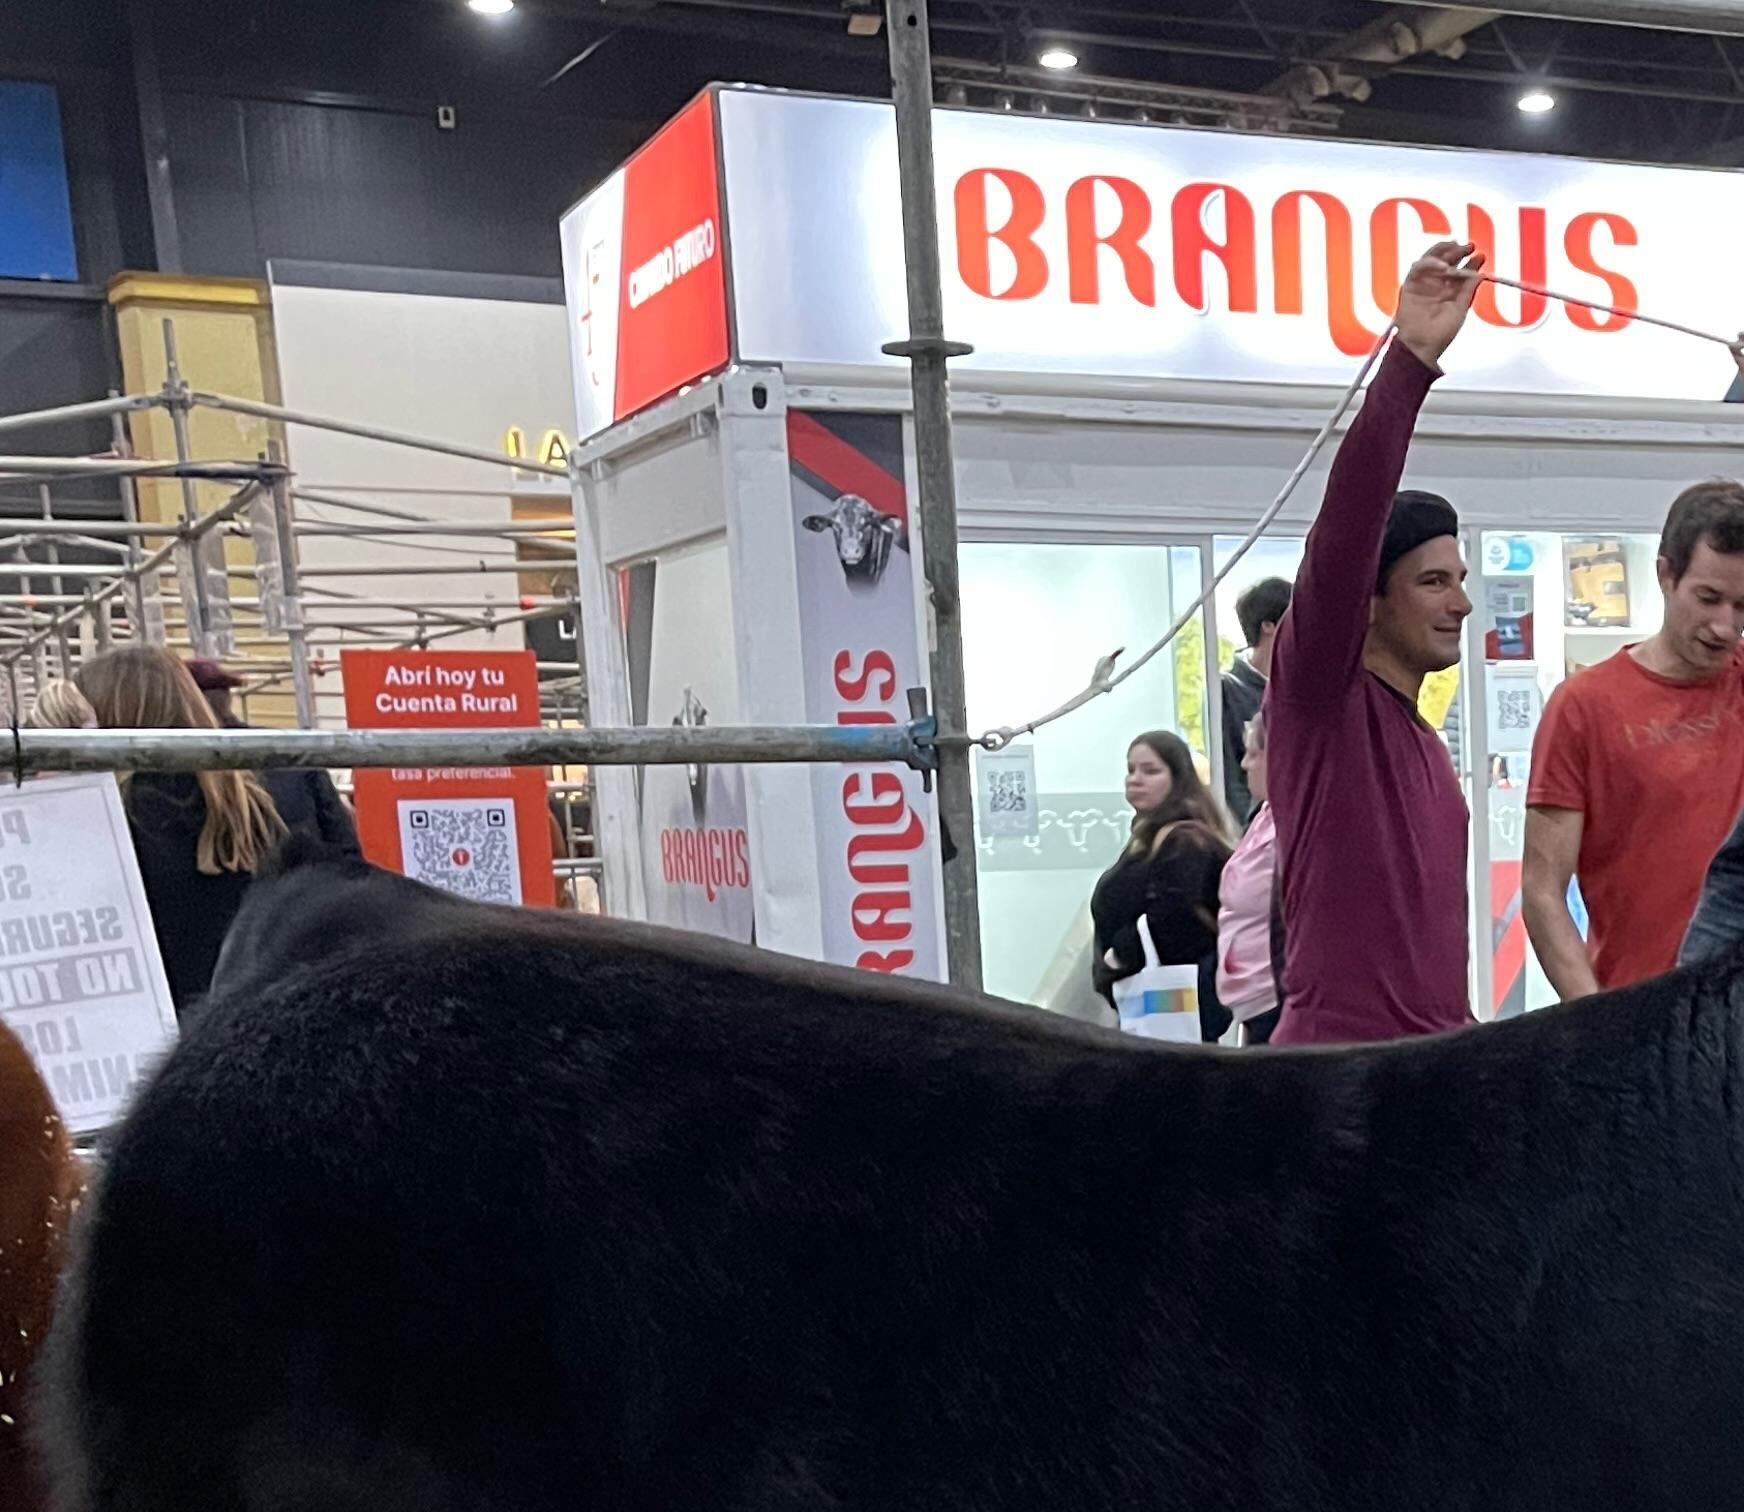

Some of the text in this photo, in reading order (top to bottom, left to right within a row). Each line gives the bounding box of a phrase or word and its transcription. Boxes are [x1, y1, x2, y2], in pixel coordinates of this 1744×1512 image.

[384, 665, 504, 690] Abrí hoy tu
[375, 693, 518, 713] Cuenta Rural
[391, 768, 422, 780] tasa
[660, 829, 750, 901] BRANGUS
